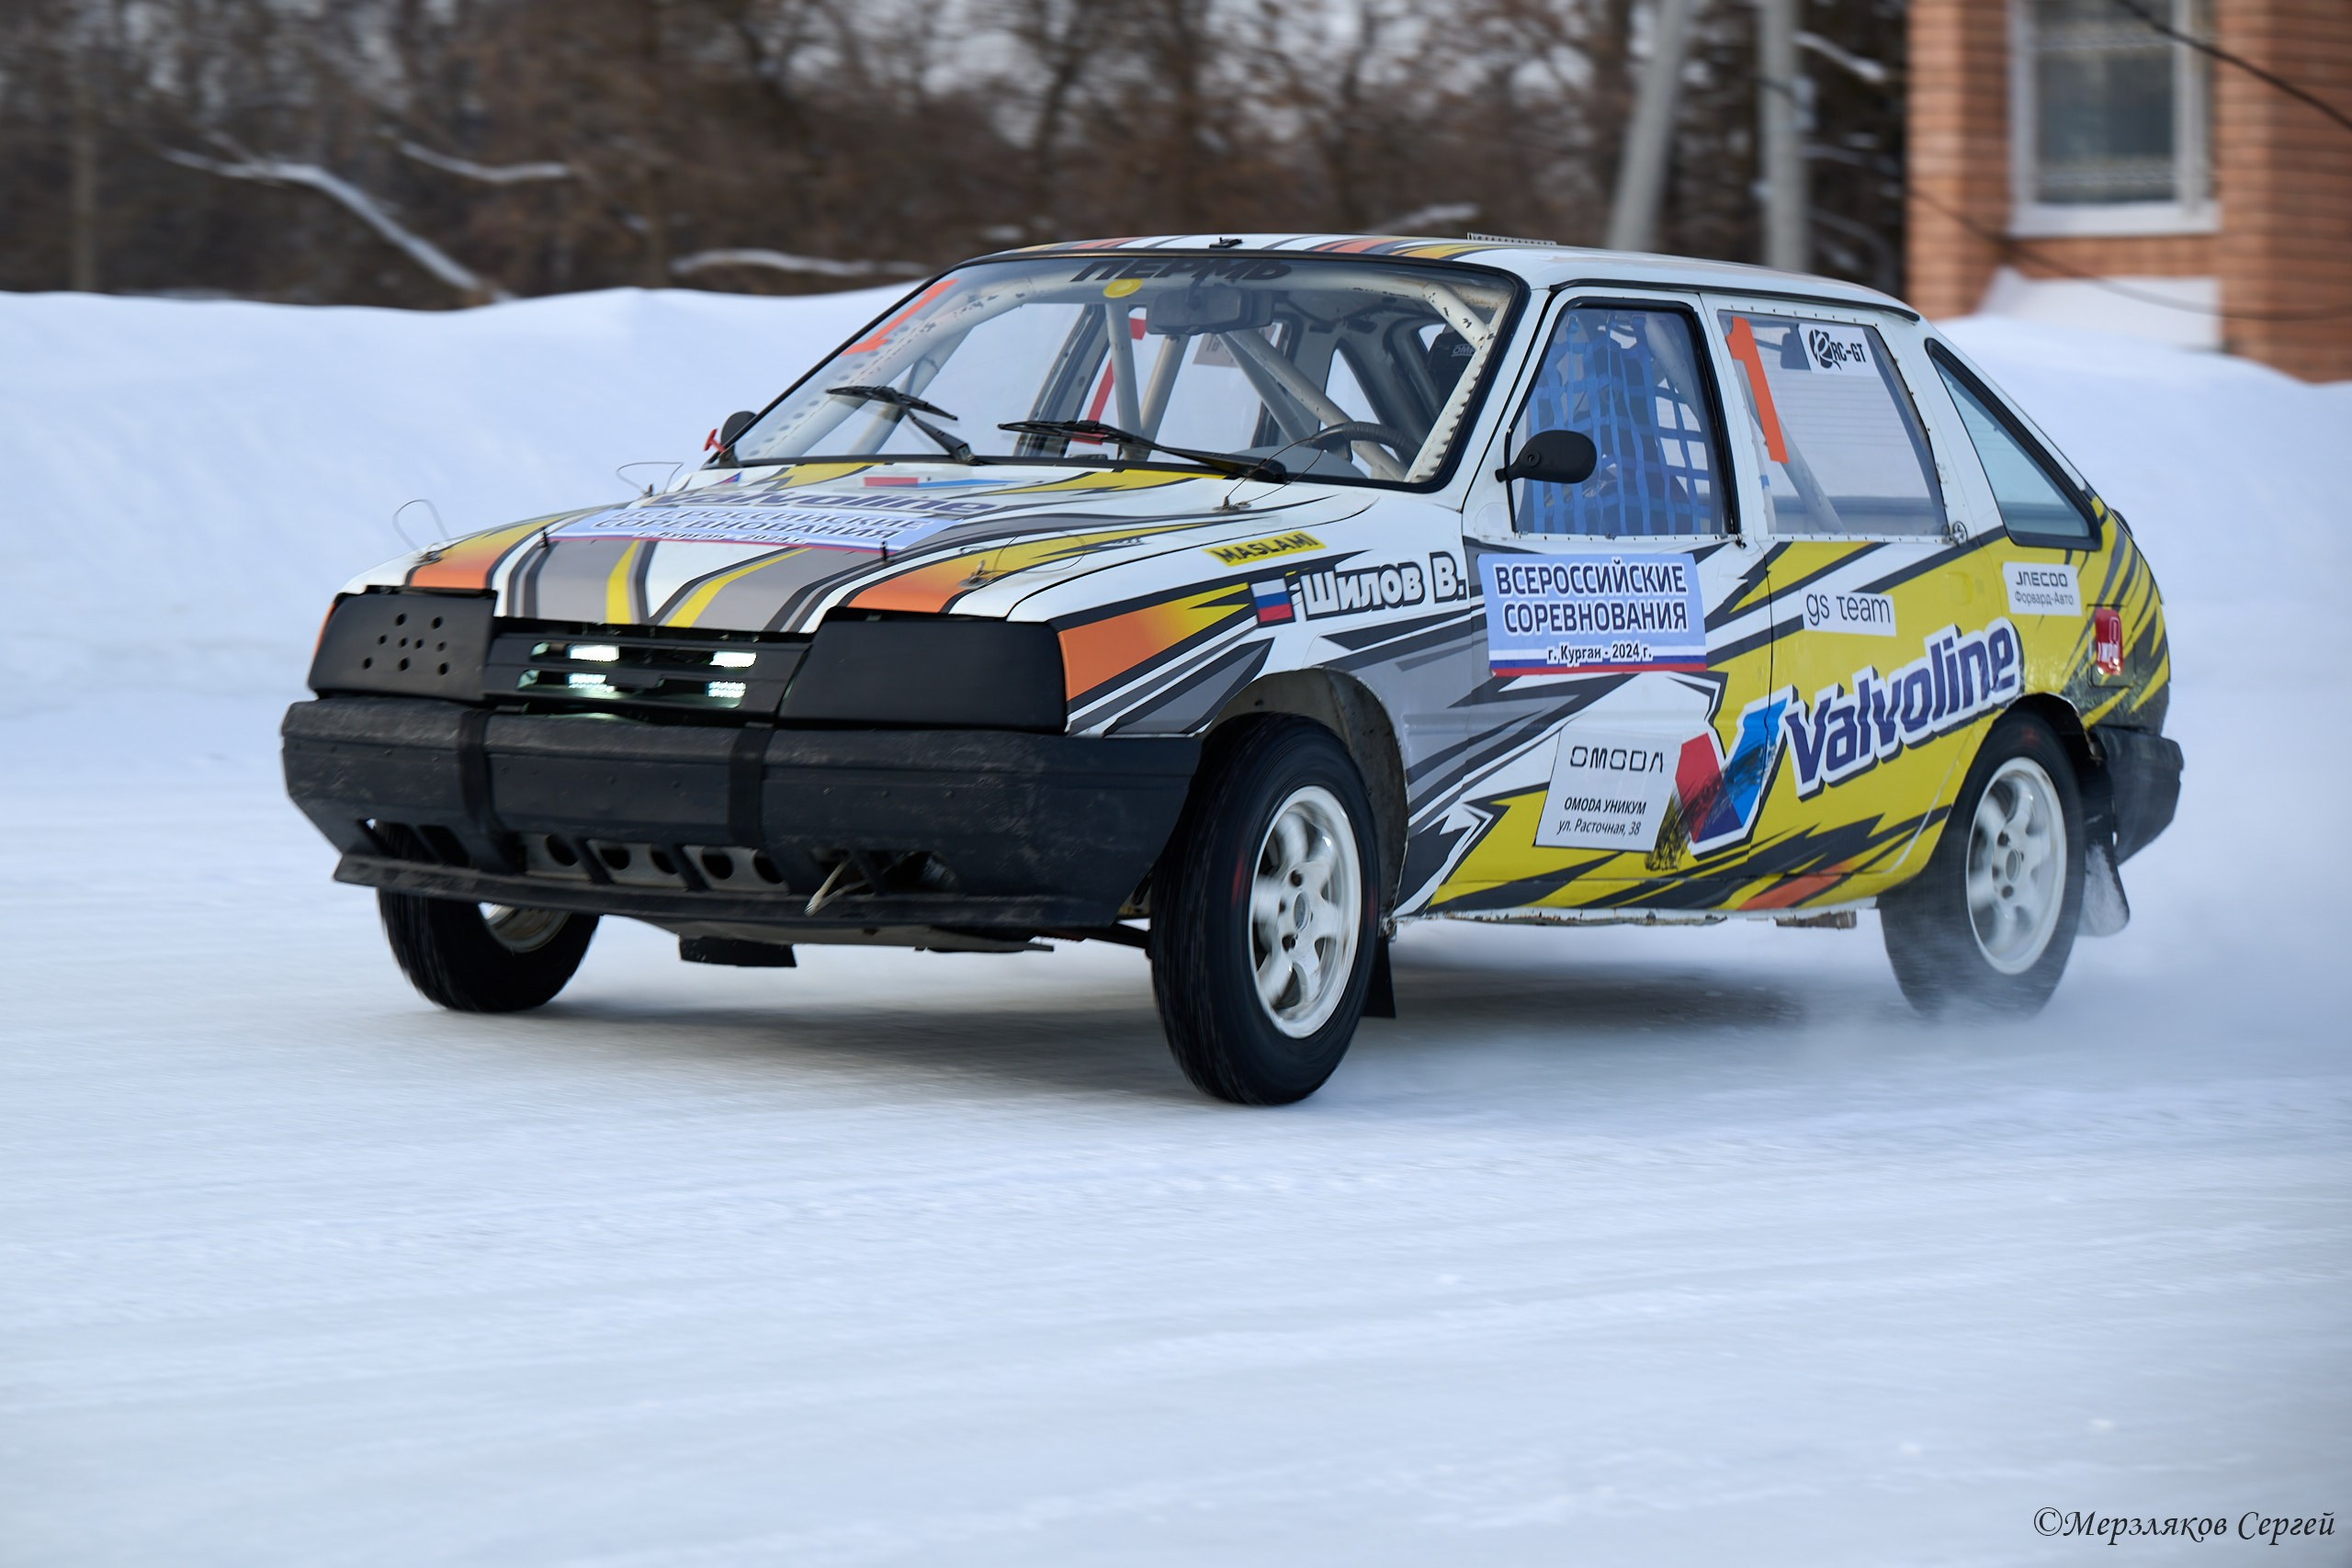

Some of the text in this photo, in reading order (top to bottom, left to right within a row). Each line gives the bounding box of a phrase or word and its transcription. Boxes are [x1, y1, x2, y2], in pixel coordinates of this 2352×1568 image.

[1069, 258, 1292, 282] ПЕРМЬ
[1725, 315, 1790, 464] 1
[650, 491, 998, 514] Valvoline
[594, 518, 900, 539] СОРЕВНОВАНИЯ
[613, 510, 929, 530] ВСЕРОССИЙСКИЕ
[1213, 532, 1318, 563] MASLAMI
[1300, 553, 1465, 618] Шилов В.
[1495, 559, 1687, 595] ВСЕРОССИЙСКИЕ
[2016, 571, 2068, 587] JAECOO
[1805, 593, 1891, 626] gs team
[2014, 591, 2074, 607] Форвард-Авто
[1504, 602, 1688, 633] СОРЕВНОВАНИЯ
[1547, 648, 1557, 660] г.
[1561, 645, 1601, 666] Курган
[1612, 644, 1640, 659] 2024
[1642, 648, 1652, 659] г.
[1784, 625, 2017, 786] Valvoline
[1570, 746, 1664, 773] OMODA
[1564, 796, 1647, 816] OMODA УНИКУМ
[1556, 818, 1642, 837] ул. Расточная, 38
